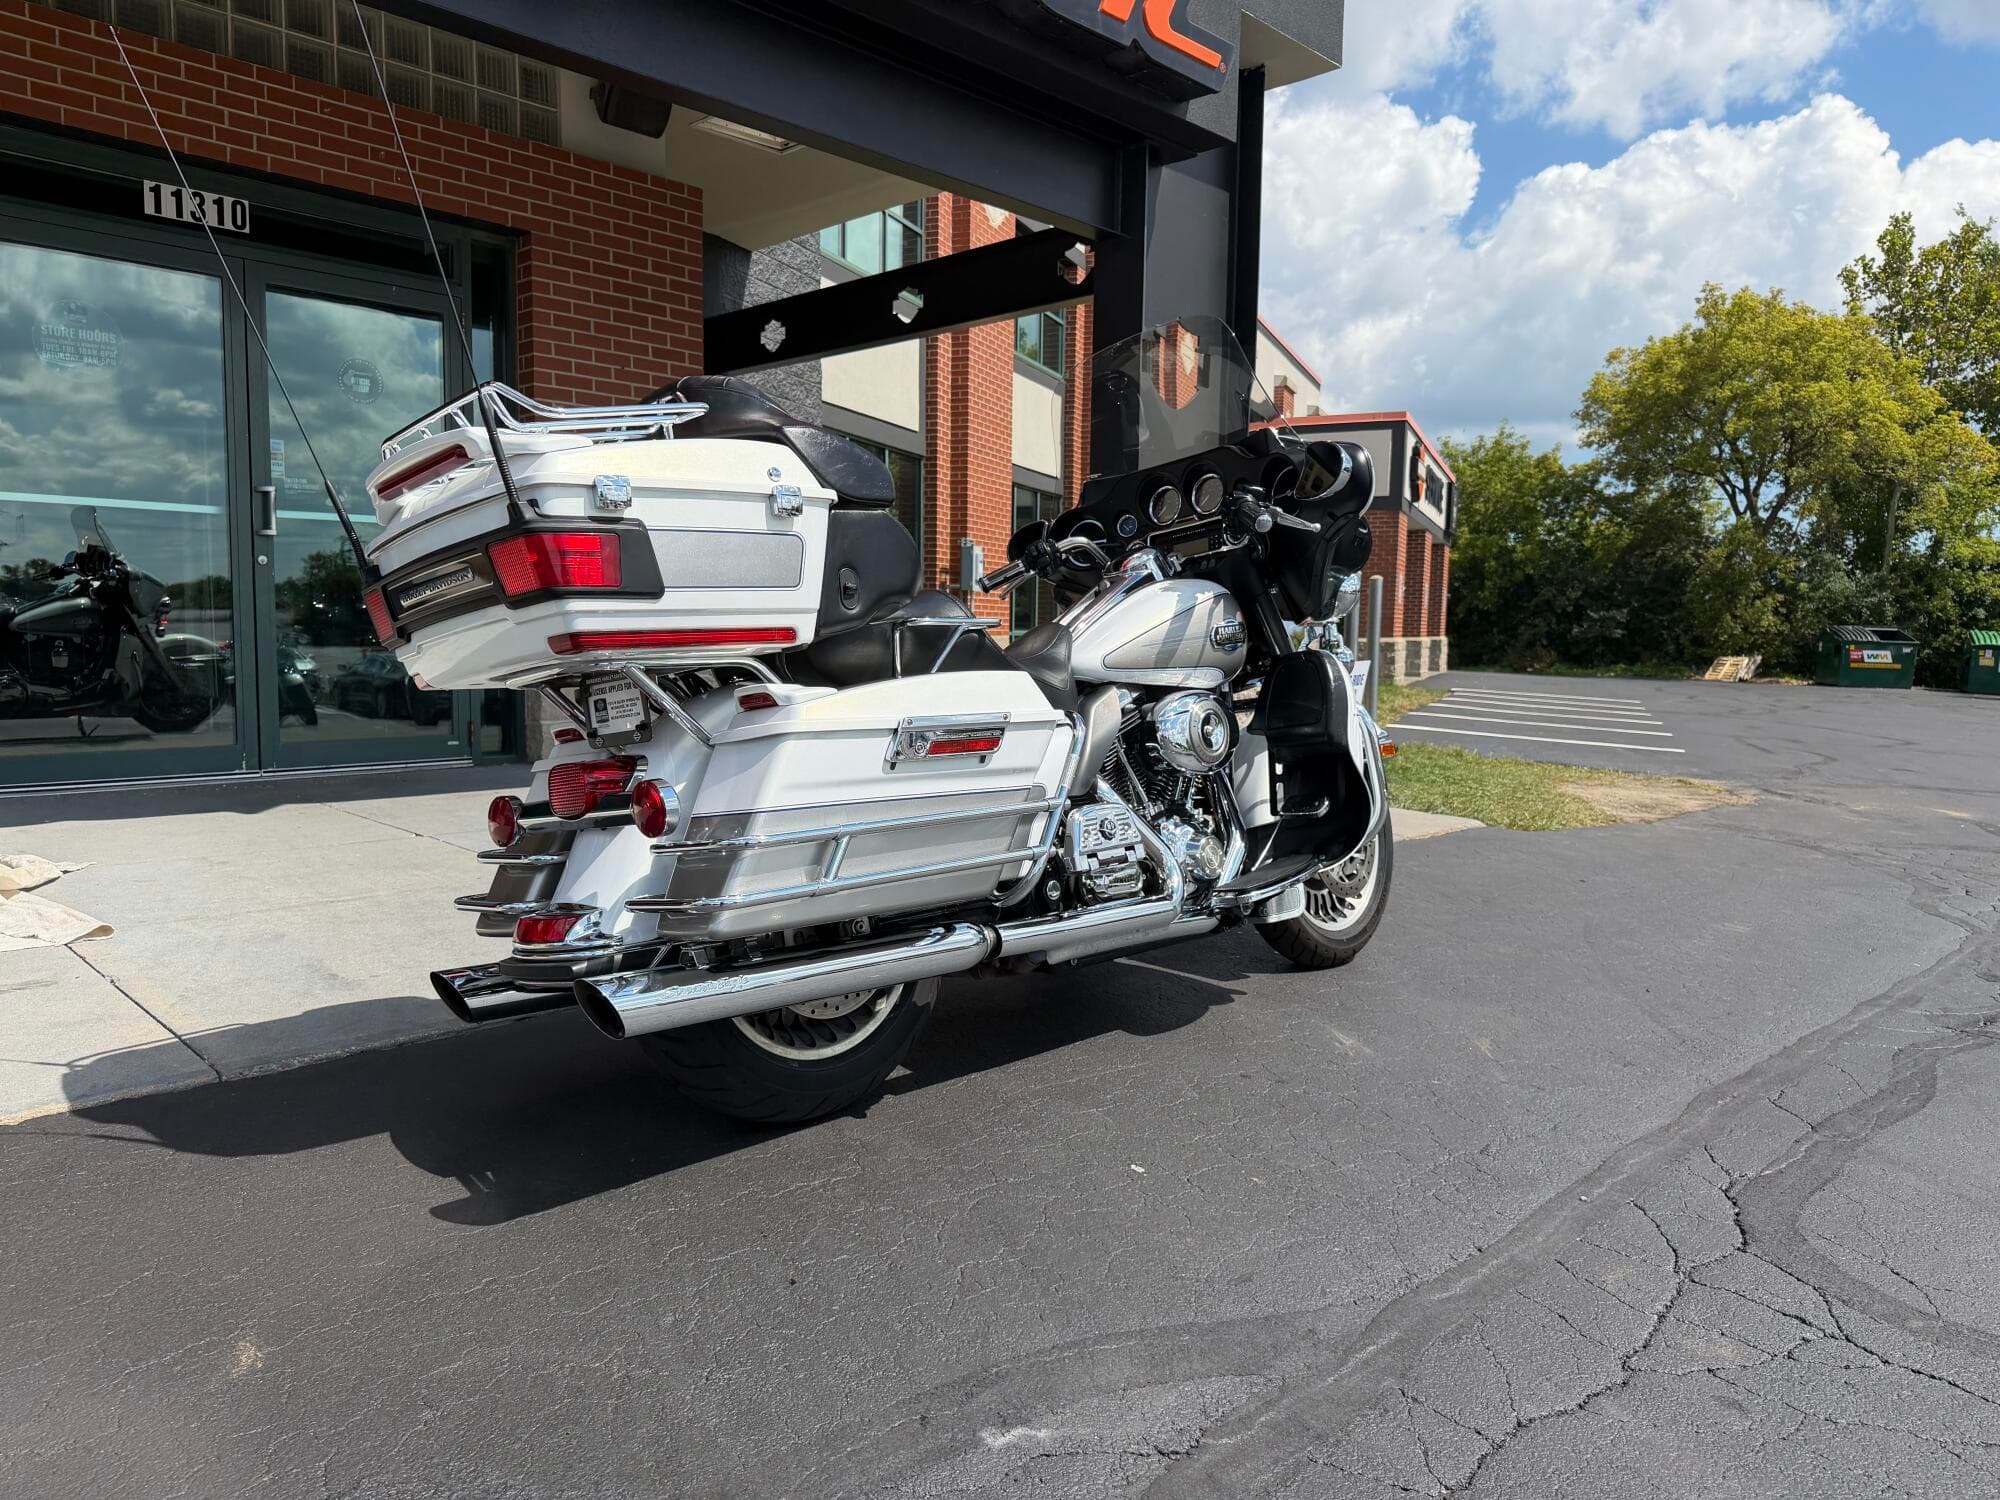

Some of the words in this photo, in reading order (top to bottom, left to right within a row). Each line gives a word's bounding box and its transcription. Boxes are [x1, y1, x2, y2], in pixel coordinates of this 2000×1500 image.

[148, 183, 248, 231] 11310
[41, 325, 75, 338] STORE
[79, 328, 117, 344] HOURS
[400, 568, 470, 602] HARLEY-DAVIDSON
